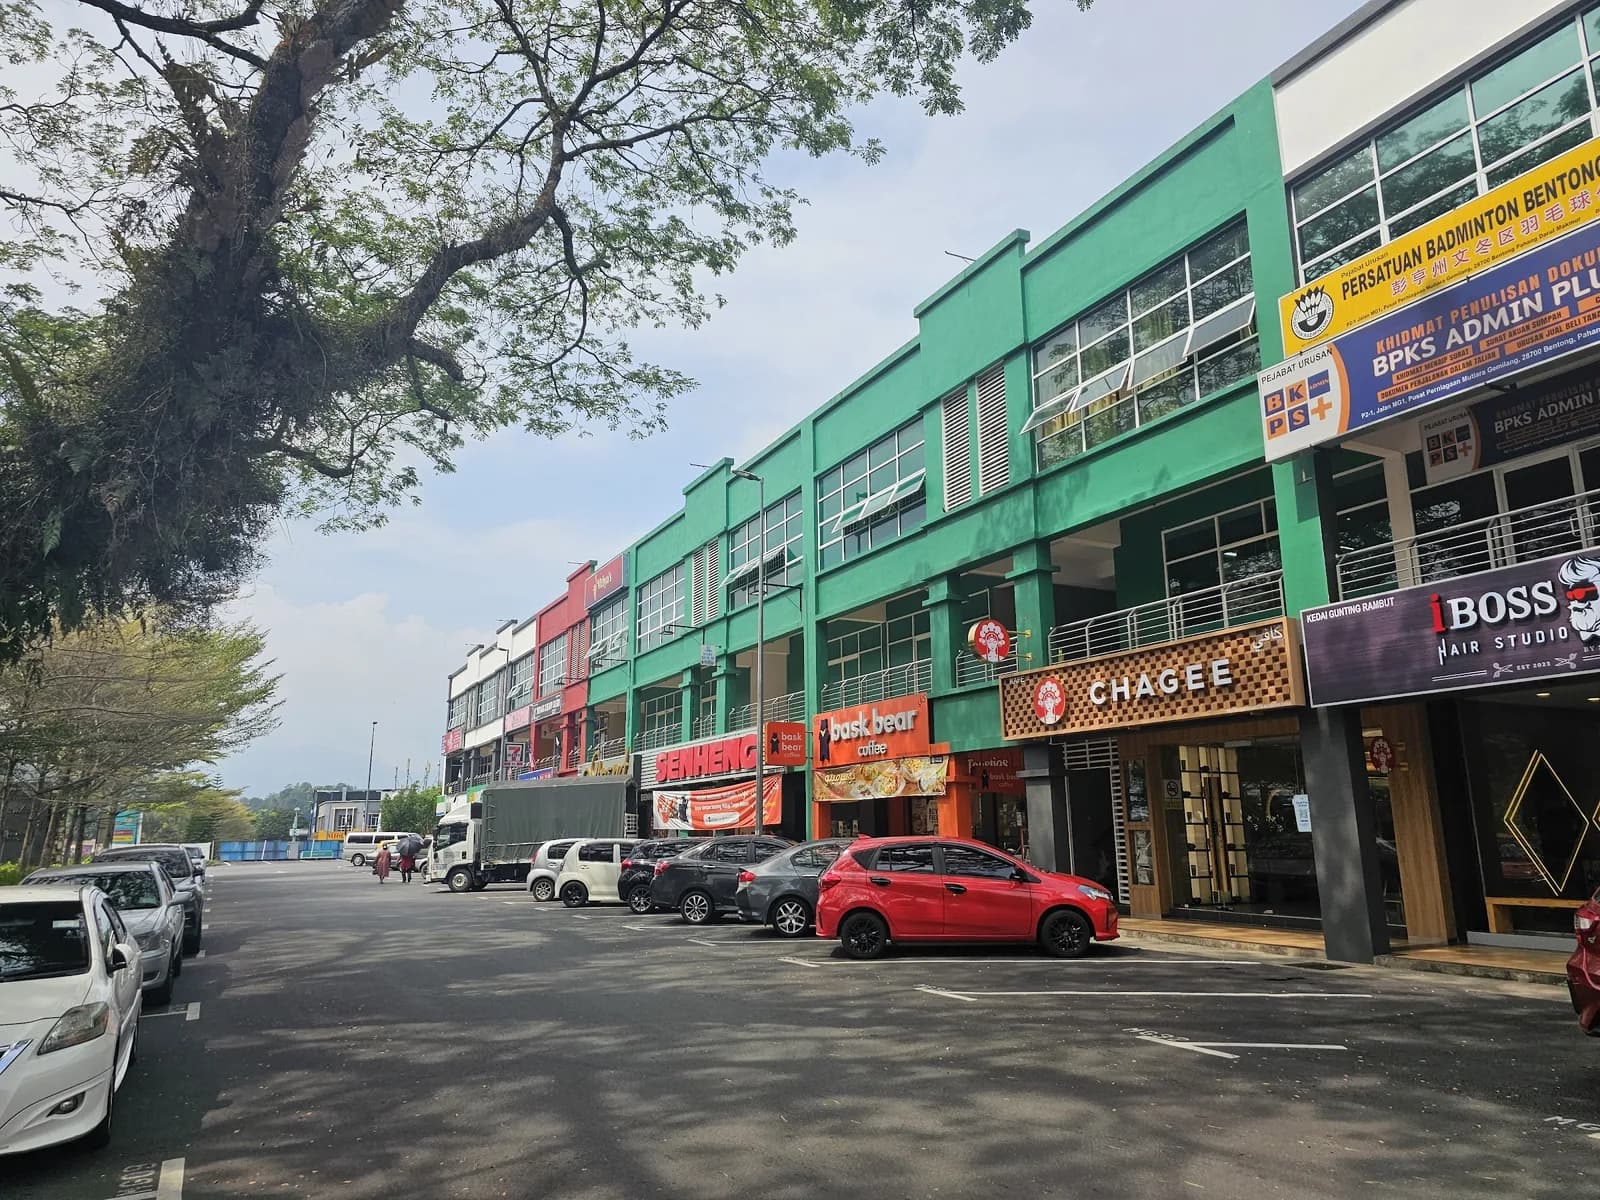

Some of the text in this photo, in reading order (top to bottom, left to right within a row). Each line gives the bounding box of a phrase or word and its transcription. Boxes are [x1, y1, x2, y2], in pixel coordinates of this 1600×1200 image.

[1342, 245, 1423, 300] PERSATUAN
[1426, 197, 1519, 260] BADMINTON
[1390, 188, 1600, 297] 彭亨州文冬区羽毛球
[1538, 229, 1555, 239] Darul
[1365, 251, 1388, 268] Urusan
[1376, 315, 1444, 354] KHIDMAT
[1449, 273, 1541, 324] PENULISAN
[1486, 334, 1506, 346] SURAT
[1531, 312, 1562, 329] SUMPAH
[1372, 336, 1437, 377] BPKS
[1445, 291, 1543, 350] ADMIN
[1516, 334, 1544, 348] URUSAN
[1545, 325, 1563, 337] JUAL
[1565, 318, 1581, 330] BELI
[1261, 347, 1333, 384] PEJABAT URUSAN
[1376, 402, 1392, 413] Jalan
[1408, 390, 1426, 402] Pusat
[1426, 378, 1461, 395] Perniagaan
[1461, 369, 1486, 382] Mutiara
[1486, 356, 1520, 373] Gemilang,
[1521, 348, 1542, 361] 28700
[1380, 385, 1409, 398] DOKUMEN
[1450, 362, 1473, 375] DALAM
[1396, 366, 1424, 380] KHIDMAT
[1449, 348, 1470, 361] SURAT
[1494, 391, 1594, 434] BPKS ADMIN
[1306, 597, 1395, 624] KEDAI GUNTING RAMBUT
[1252, 626, 1283, 652] كافي
[1438, 626, 1568, 666] HAIR STUDIO
[1089, 658, 1233, 705] CHAGEE
[781, 732, 801, 741] bask
[830, 707, 918, 742] bask bear
[781, 742, 801, 751] bear
[857, 740, 888, 757] coffee
